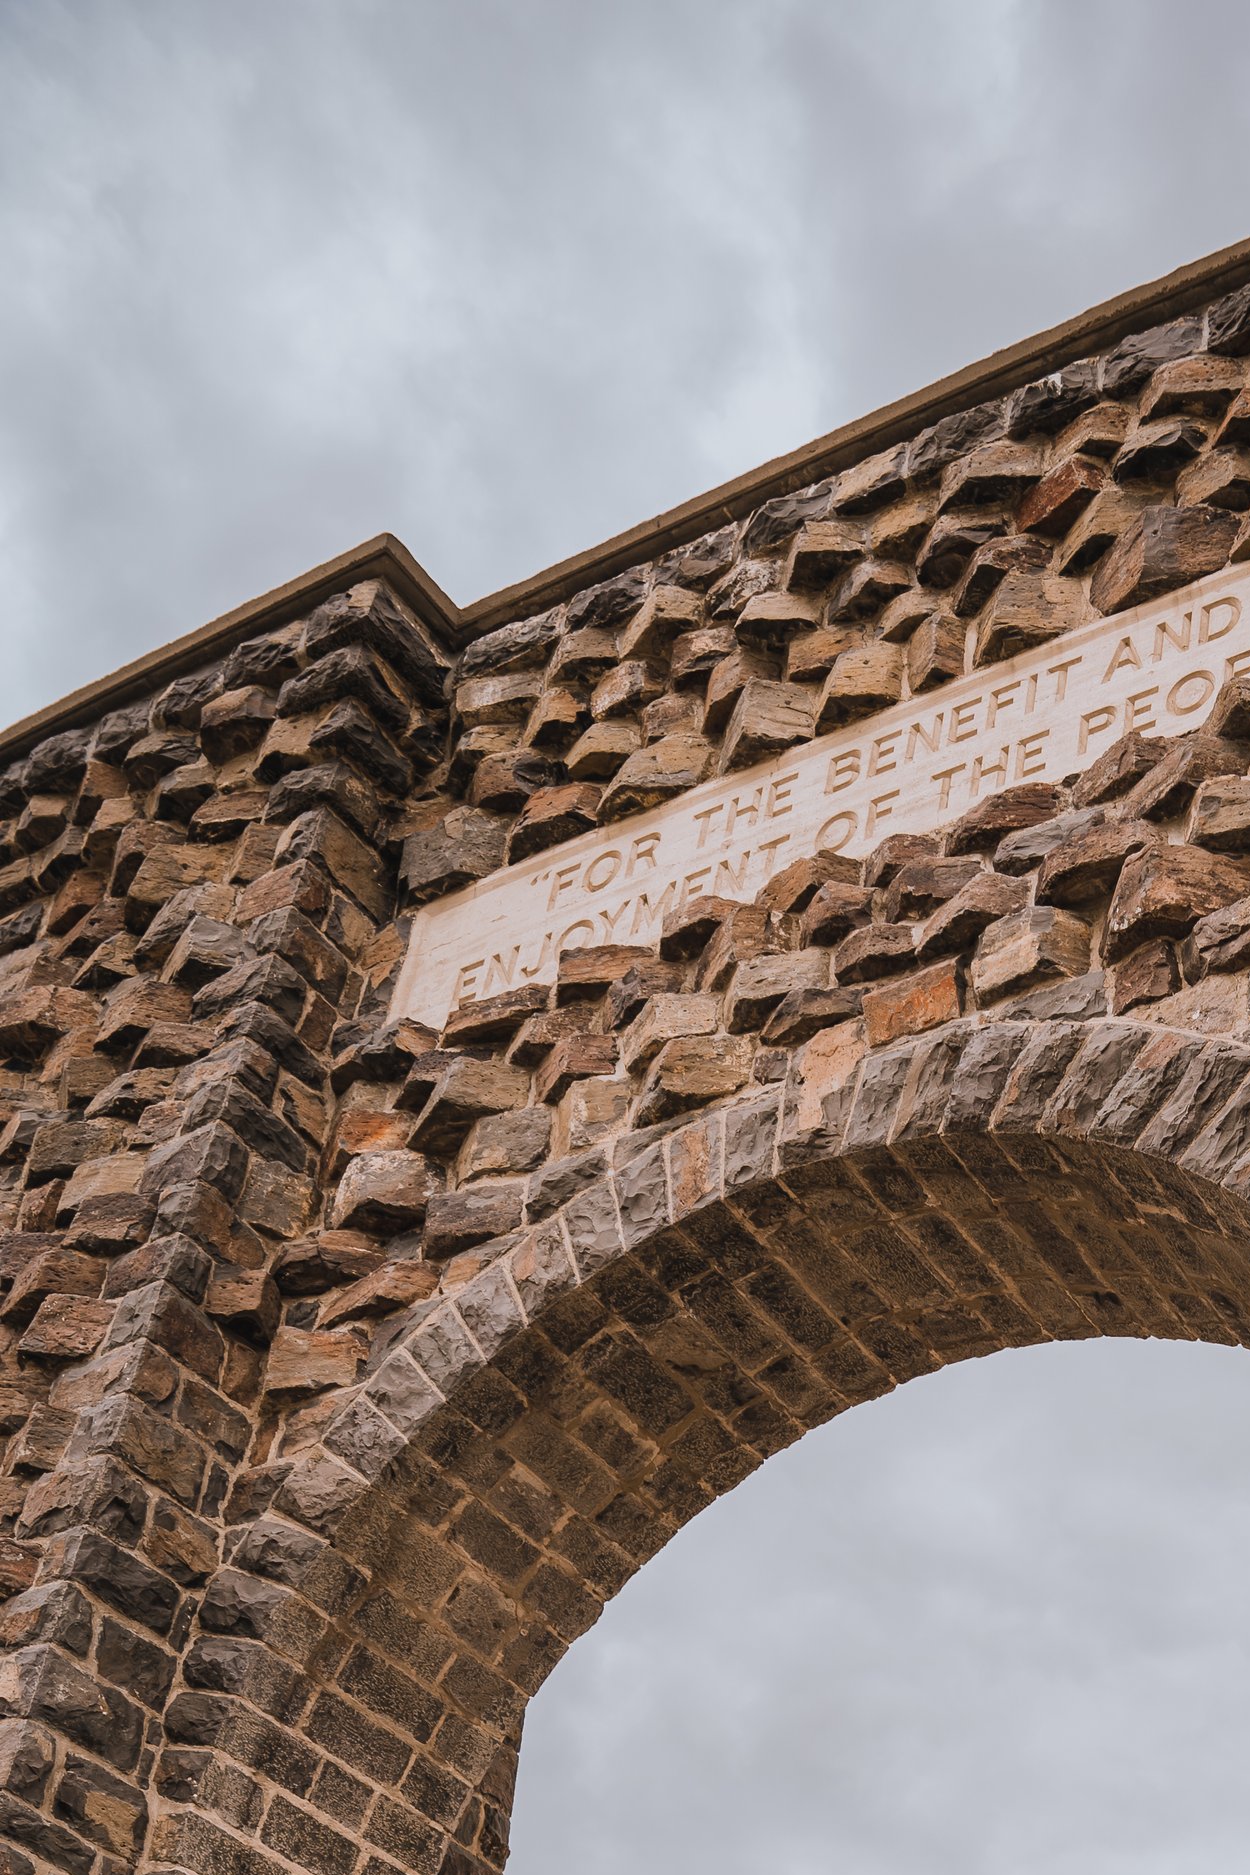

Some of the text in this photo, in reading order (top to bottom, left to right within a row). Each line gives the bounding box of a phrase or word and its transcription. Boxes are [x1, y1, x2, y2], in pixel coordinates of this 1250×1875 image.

[693, 772, 799, 849] THE
[824, 654, 1083, 796] BENEFIT
[1101, 595, 1243, 685] AND
[814, 788, 901, 853] OF
[932, 728, 1050, 811] THE
